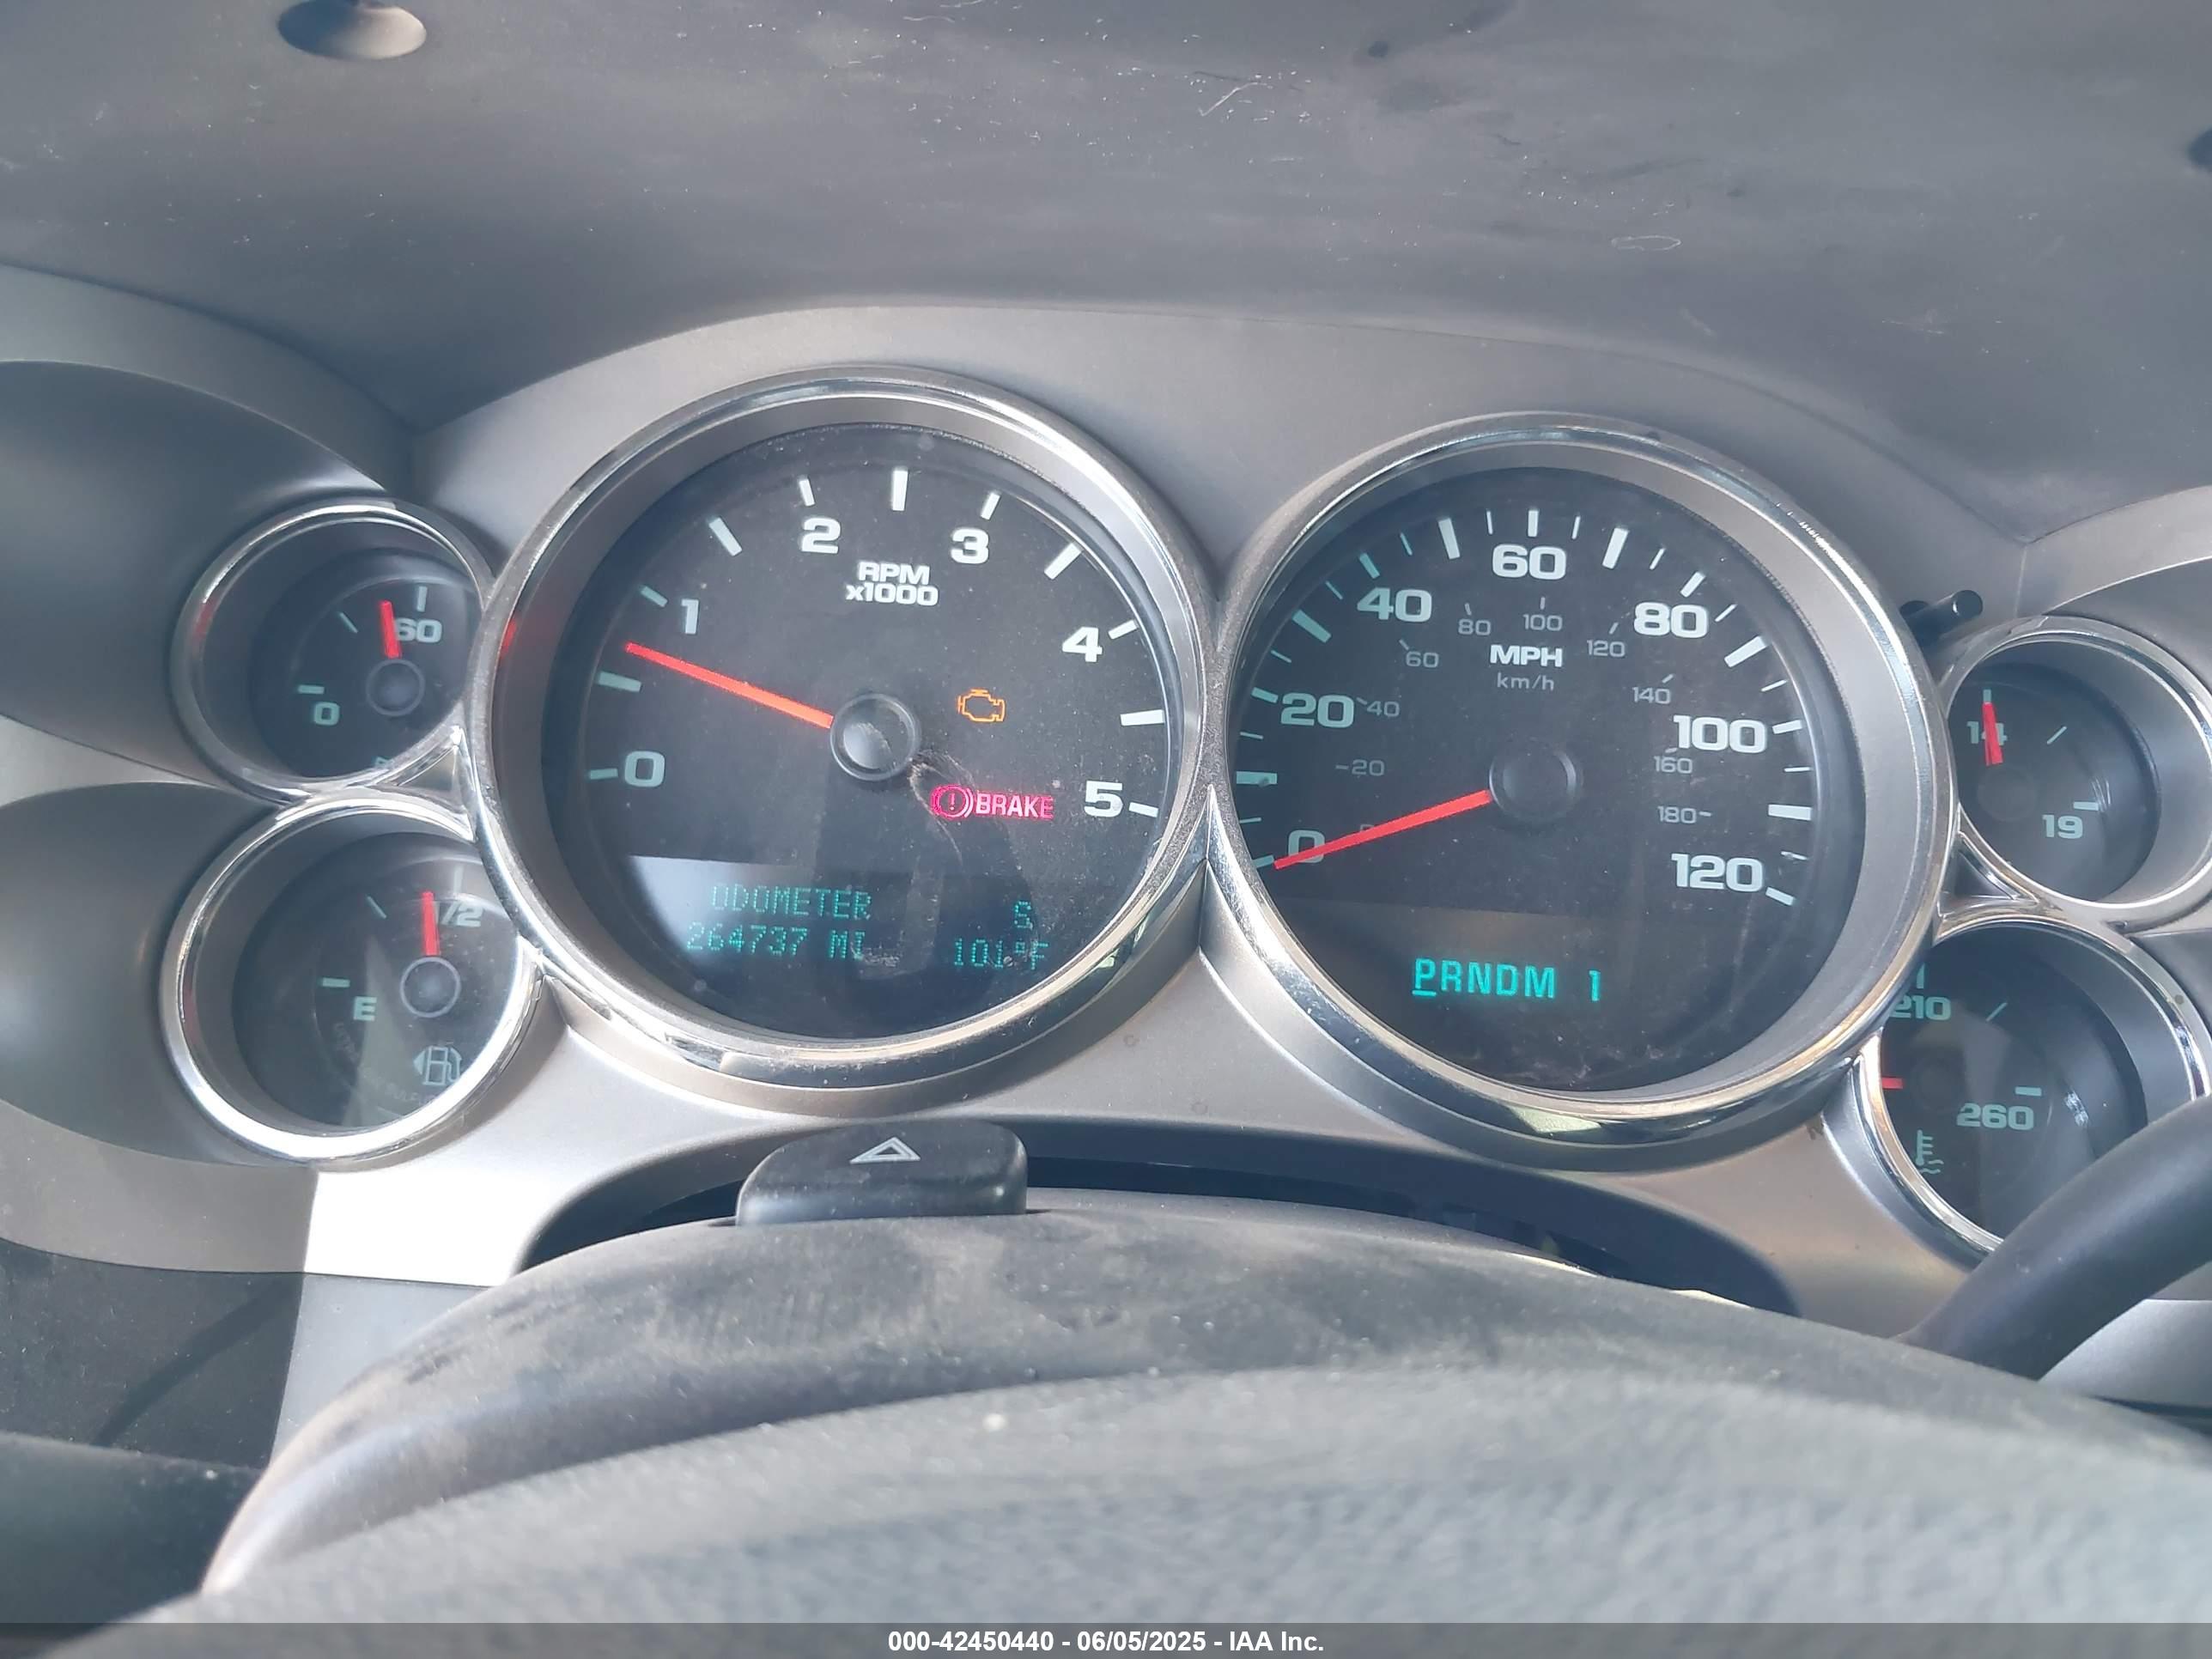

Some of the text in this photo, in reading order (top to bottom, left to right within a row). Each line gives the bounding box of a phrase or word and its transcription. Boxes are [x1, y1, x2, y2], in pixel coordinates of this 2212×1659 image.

[801, 517, 842, 555] 2
[950, 528, 990, 565] 3
[858, 562, 931, 586] RPM
[1492, 543, 1567, 580] 60
[845, 581, 939, 607] x1000
[1357, 587, 1432, 623] 40
[681, 599, 700, 635] 1
[1458, 618, 1492, 637] 80
[1522, 613, 1563, 633] 100
[1633, 602, 1709, 639] 80
[1061, 626, 1103, 663] 4
[1489, 643, 1563, 669] MPH
[1586, 638, 1626, 658] 120
[1405, 650, 1439, 669] 60
[1497, 671, 1555, 690] km/h
[1280, 692, 1355, 727] 20
[1365, 700, 1401, 719] 40
[1632, 686, 1671, 705] 140
[313, 702, 341, 726] 0
[1673, 714, 1766, 754] 100
[623, 750, 666, 788] 0
[1350, 758, 1385, 777] 20
[1653, 755, 1693, 775] 160
[973, 793, 1055, 821] BRAKE
[1084, 781, 1124, 818] 5
[1657, 805, 1697, 824] 180
[2042, 813, 2084, 840] 19
[1670, 852, 1764, 893] 120
[709, 882, 872, 921] ODOMETER
[686, 921, 809, 958] 264737
[1412, 957, 1602, 1003] PRNDM 1
[352, 995, 378, 1023] E
[1955, 1102, 2035, 1131] 260
